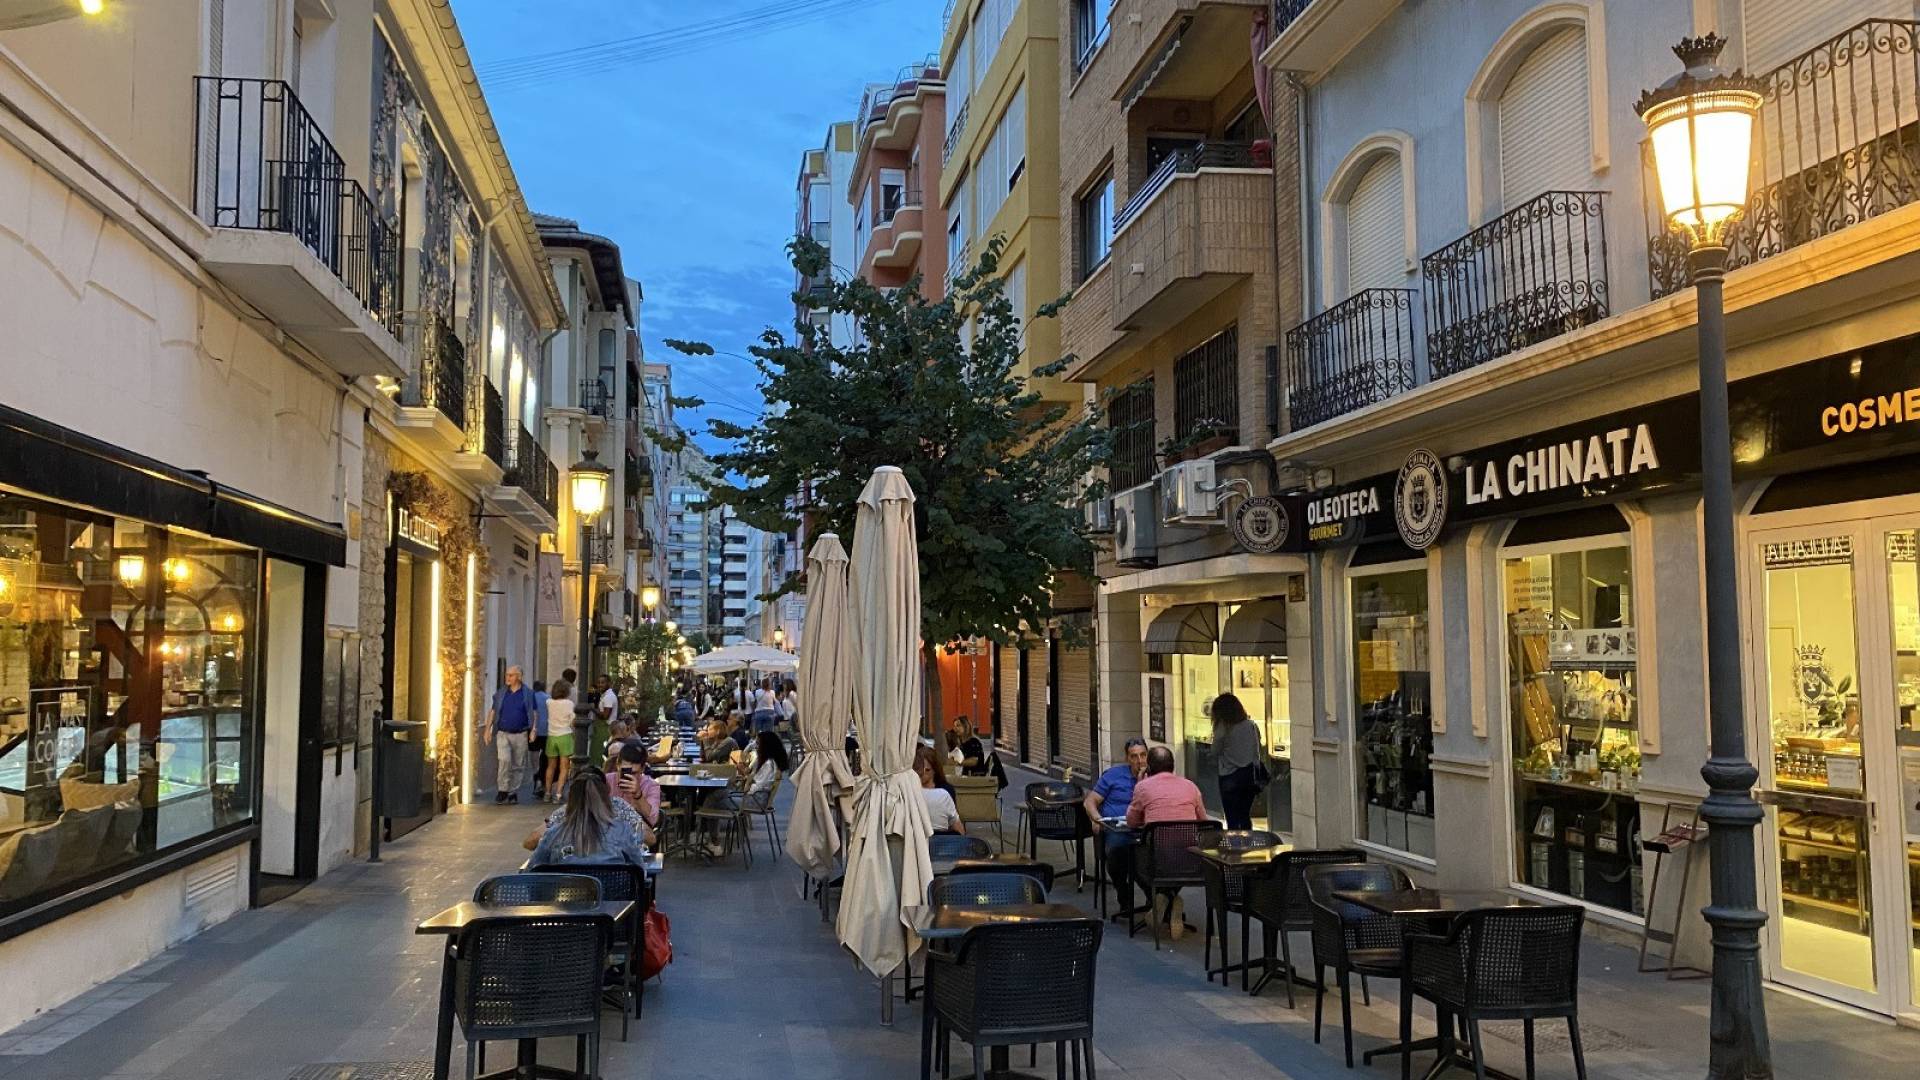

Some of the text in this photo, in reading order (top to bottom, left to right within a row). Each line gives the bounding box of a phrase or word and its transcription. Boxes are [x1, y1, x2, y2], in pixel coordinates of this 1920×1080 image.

[1466, 423, 1661, 505] LA CHINATA
[1307, 486, 1380, 525] OLEOTECA
[1308, 522, 1344, 541] GOURMET
